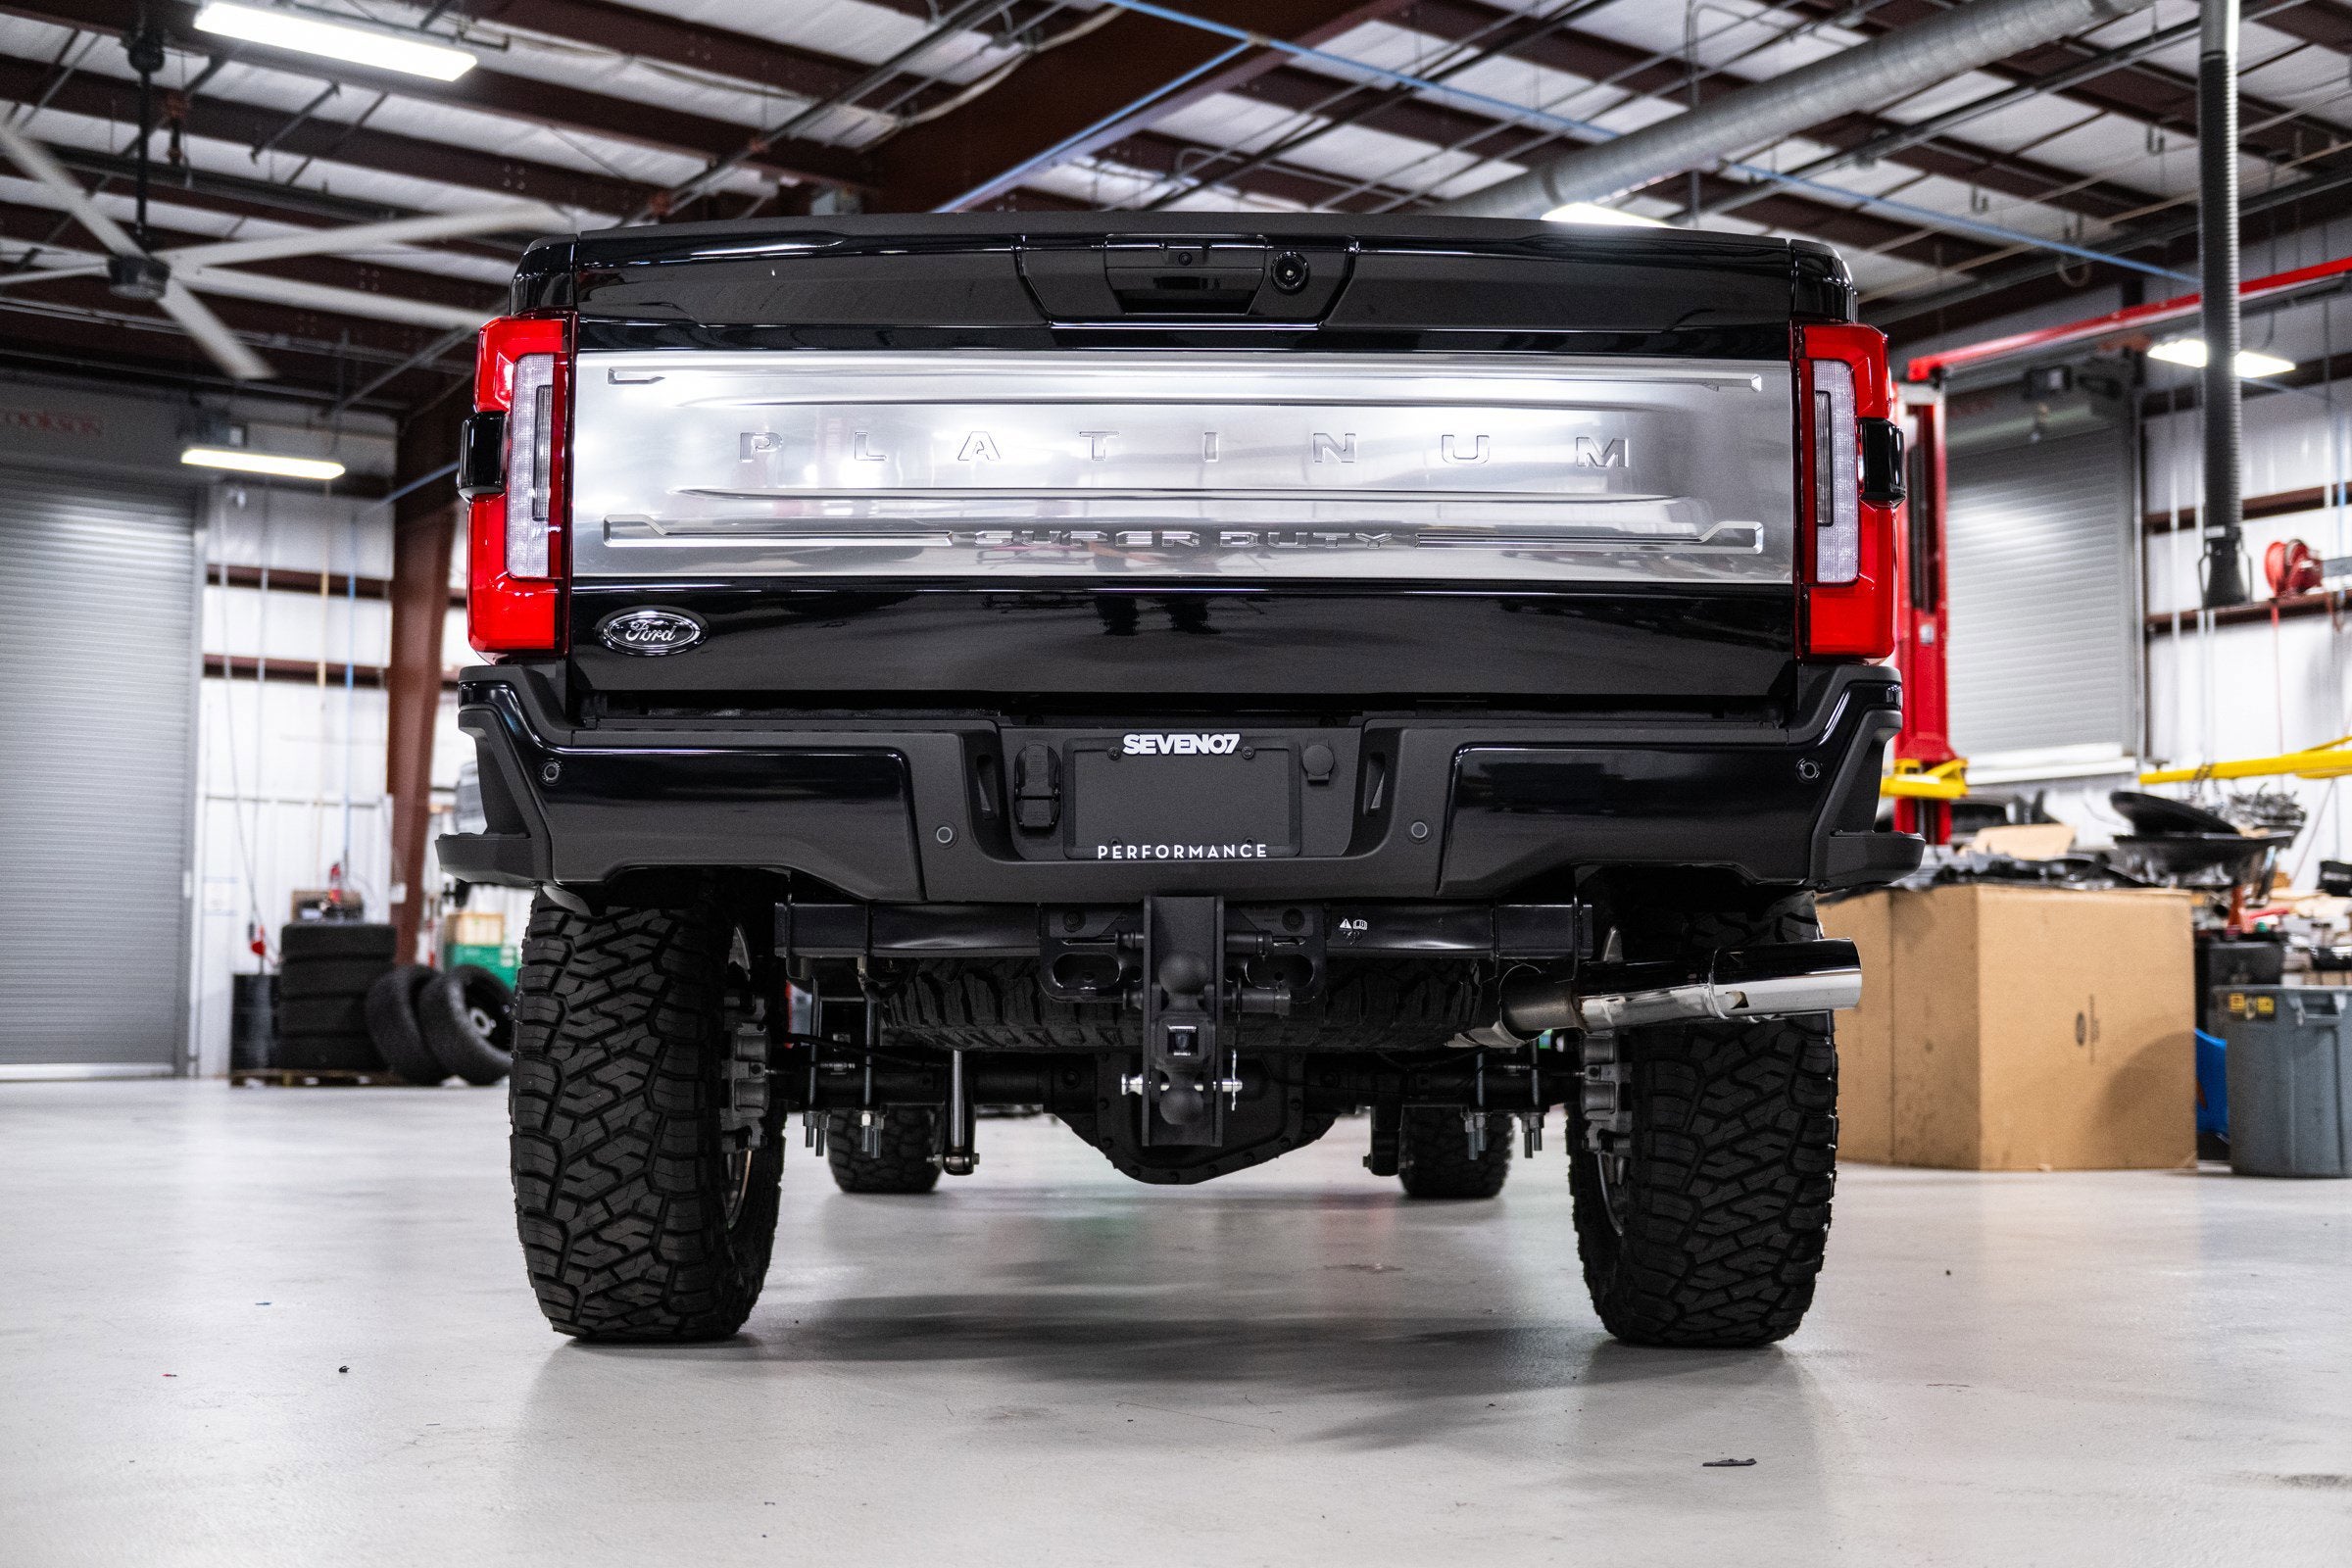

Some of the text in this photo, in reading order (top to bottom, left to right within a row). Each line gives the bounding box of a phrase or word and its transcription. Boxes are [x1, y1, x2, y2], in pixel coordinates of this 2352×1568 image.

[739, 431, 1629, 467] PLATINUM
[974, 530, 1393, 549] SUPER DUTY
[625, 619, 677, 641] Ford
[1098, 844, 1267, 859] PERFORMANCE
